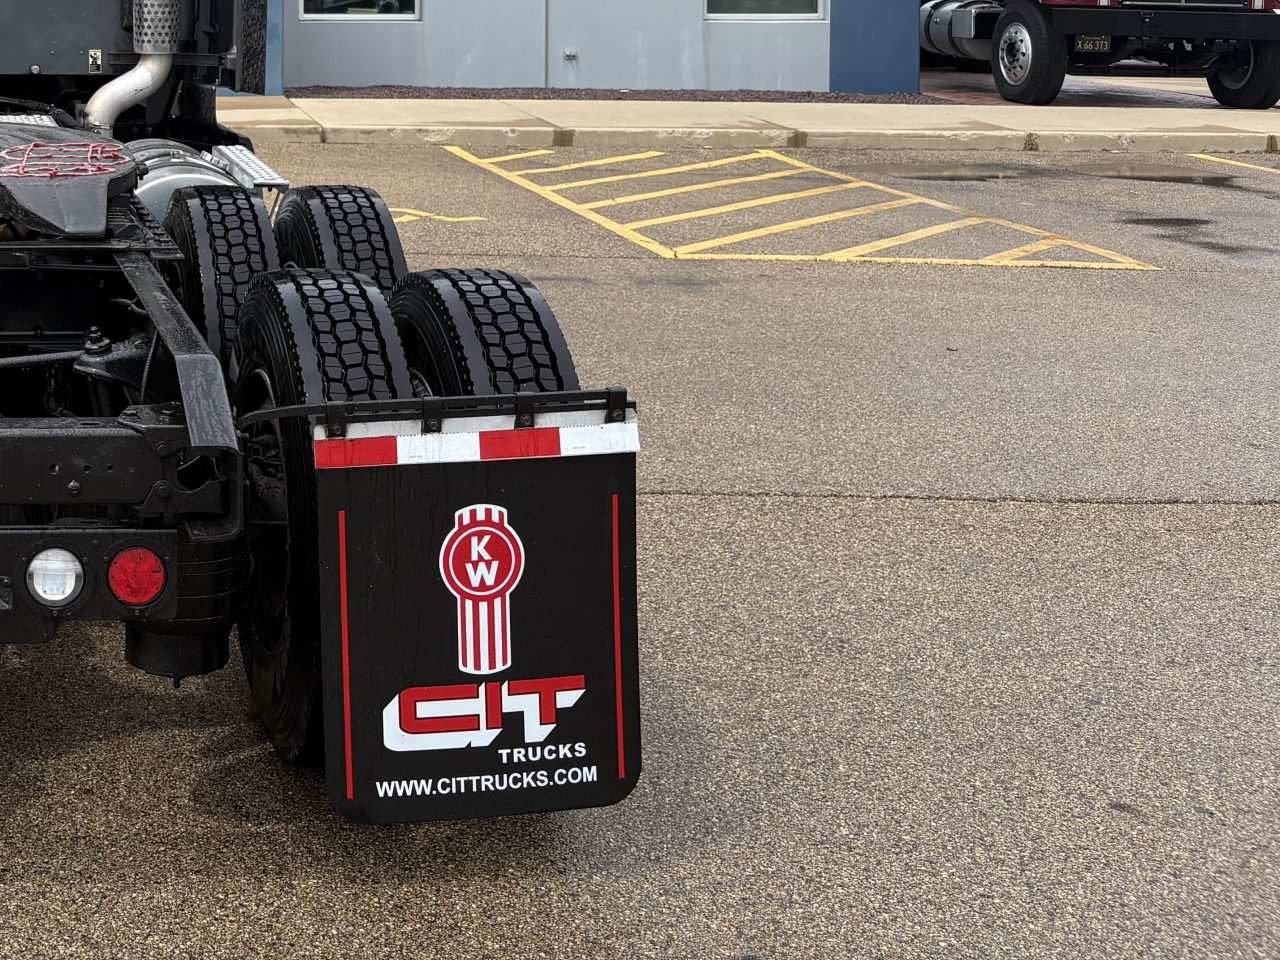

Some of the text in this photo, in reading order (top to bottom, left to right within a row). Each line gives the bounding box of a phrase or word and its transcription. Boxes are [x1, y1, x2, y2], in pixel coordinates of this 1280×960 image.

[382, 674, 587, 752] CIT
[498, 742, 587, 764] TRUCKS
[375, 765, 598, 798] WWW.CITTRUCKS.COM
